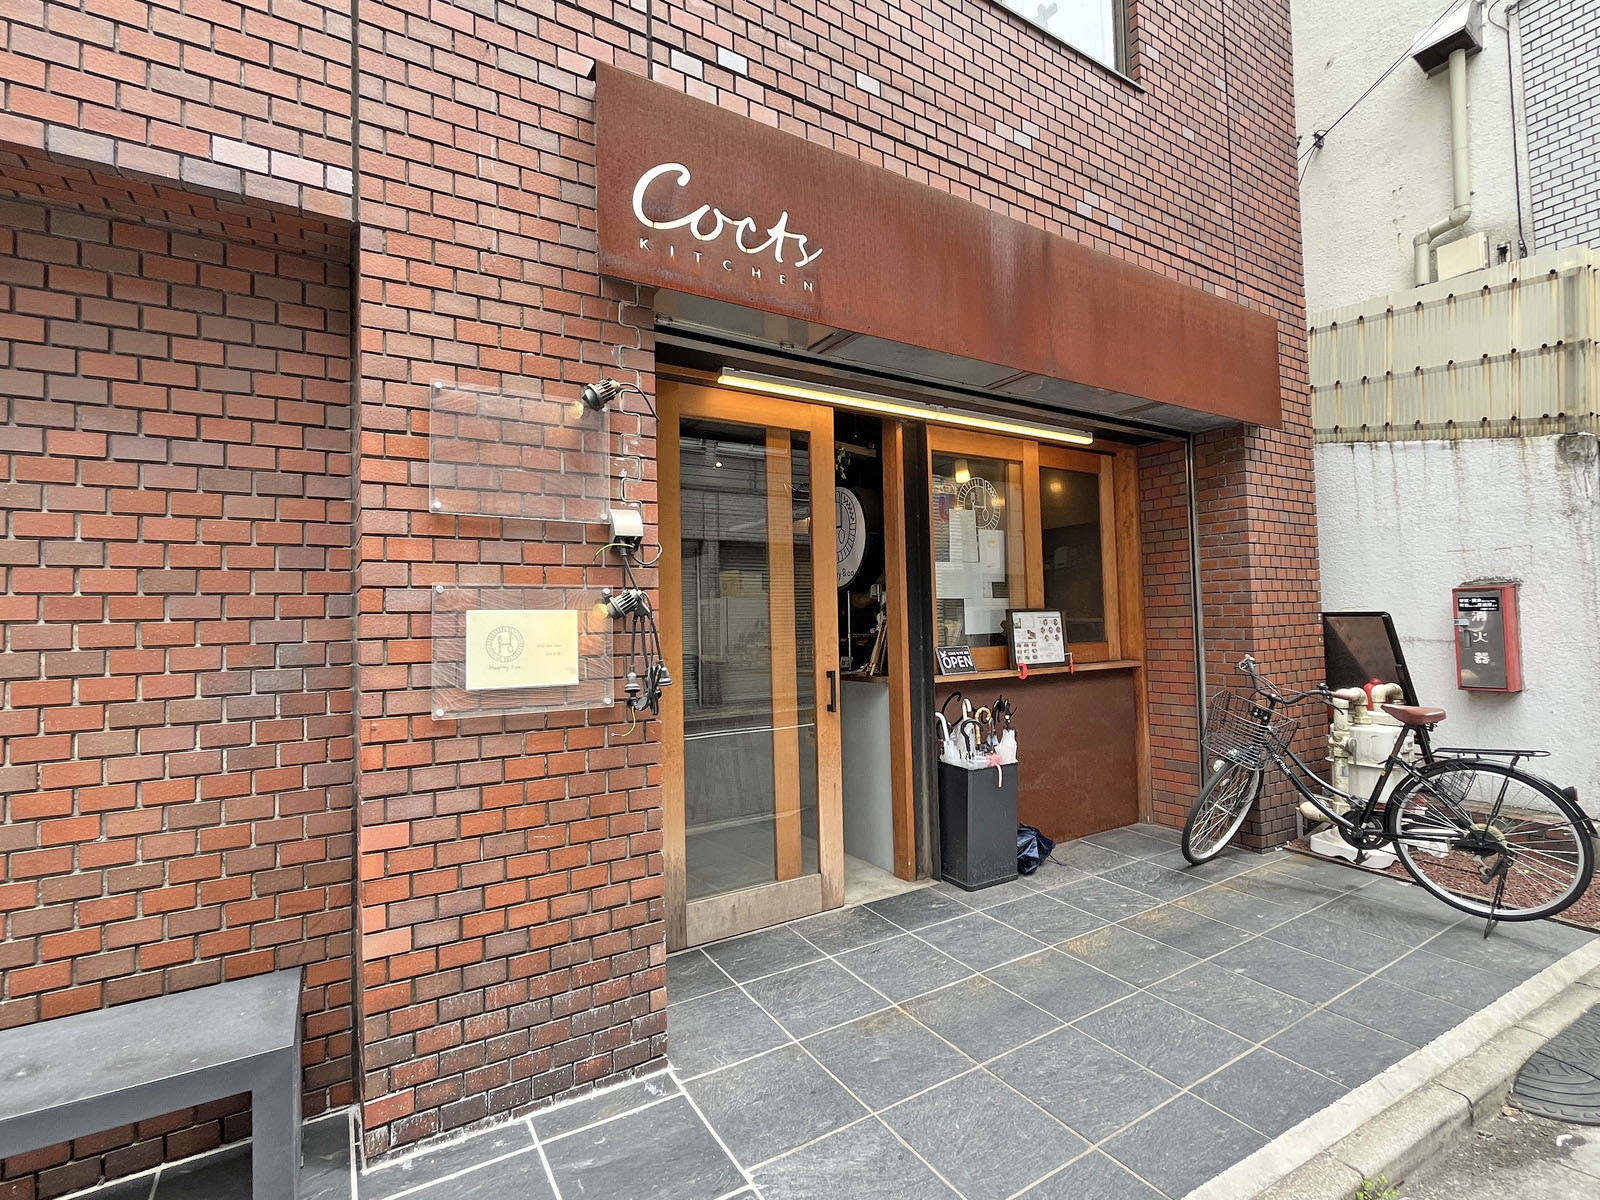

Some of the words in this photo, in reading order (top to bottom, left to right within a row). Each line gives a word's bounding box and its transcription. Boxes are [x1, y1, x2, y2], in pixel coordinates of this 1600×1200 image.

[639, 237, 814, 293] KITCHEN
[942, 655, 974, 669] OPEN
[1471, 611, 1491, 664] 消火器
